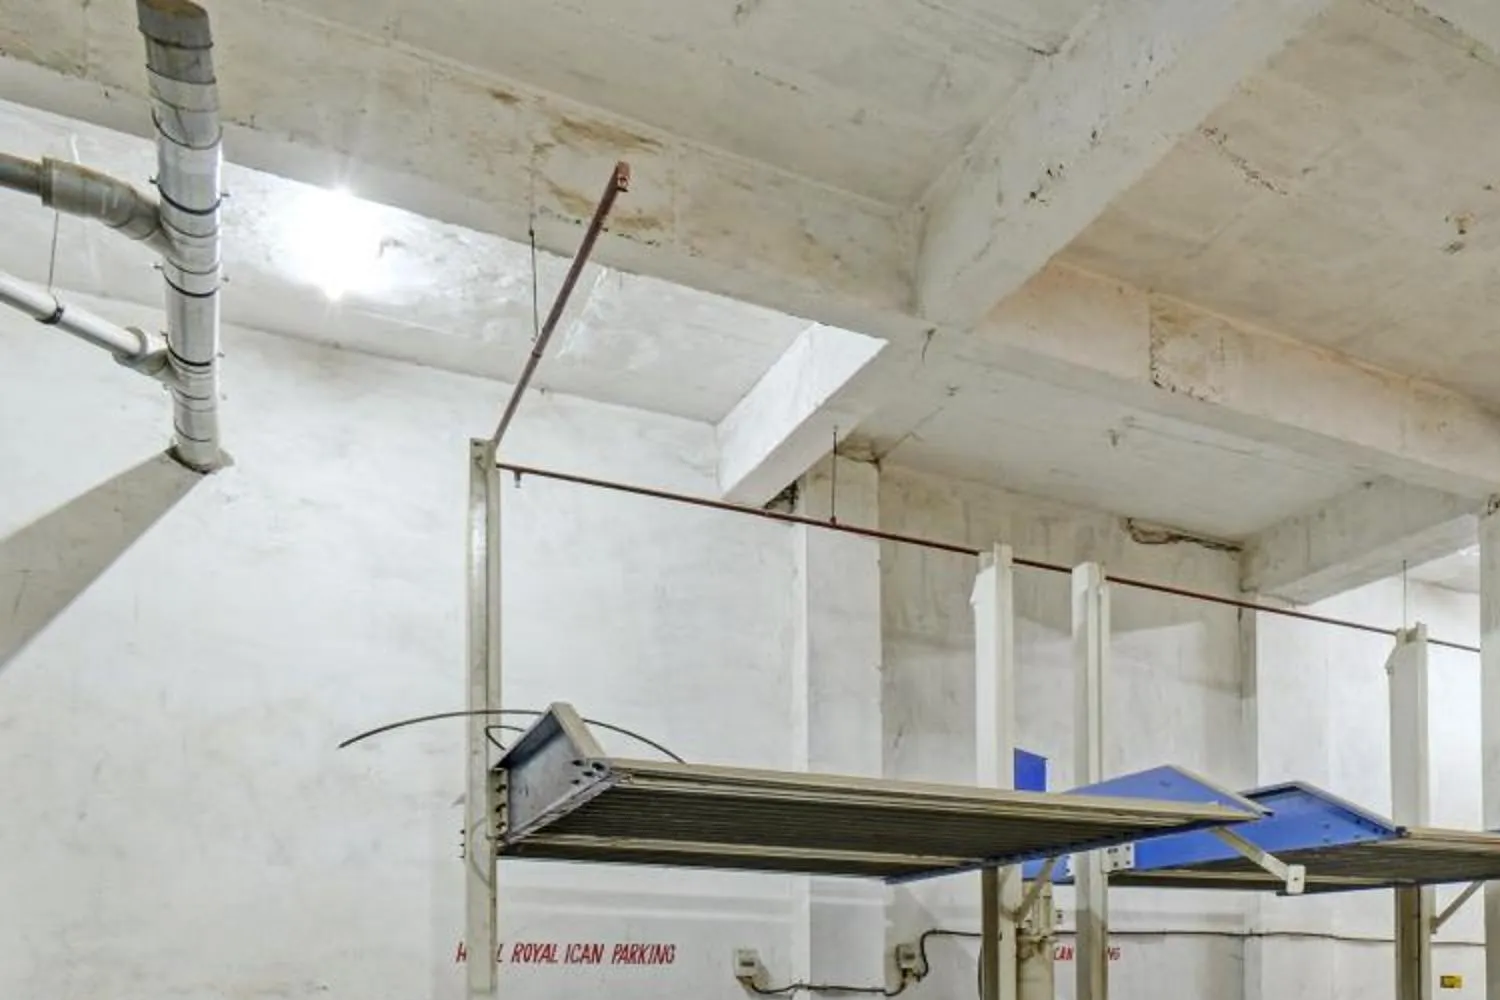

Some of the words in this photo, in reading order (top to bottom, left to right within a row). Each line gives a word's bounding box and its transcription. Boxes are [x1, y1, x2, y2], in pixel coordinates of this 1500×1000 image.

[511, 943, 558, 963] ROYAL
[564, 943, 604, 964] ICAN
[611, 943, 676, 964] PARKING
[1053, 946, 1073, 961] CAN
